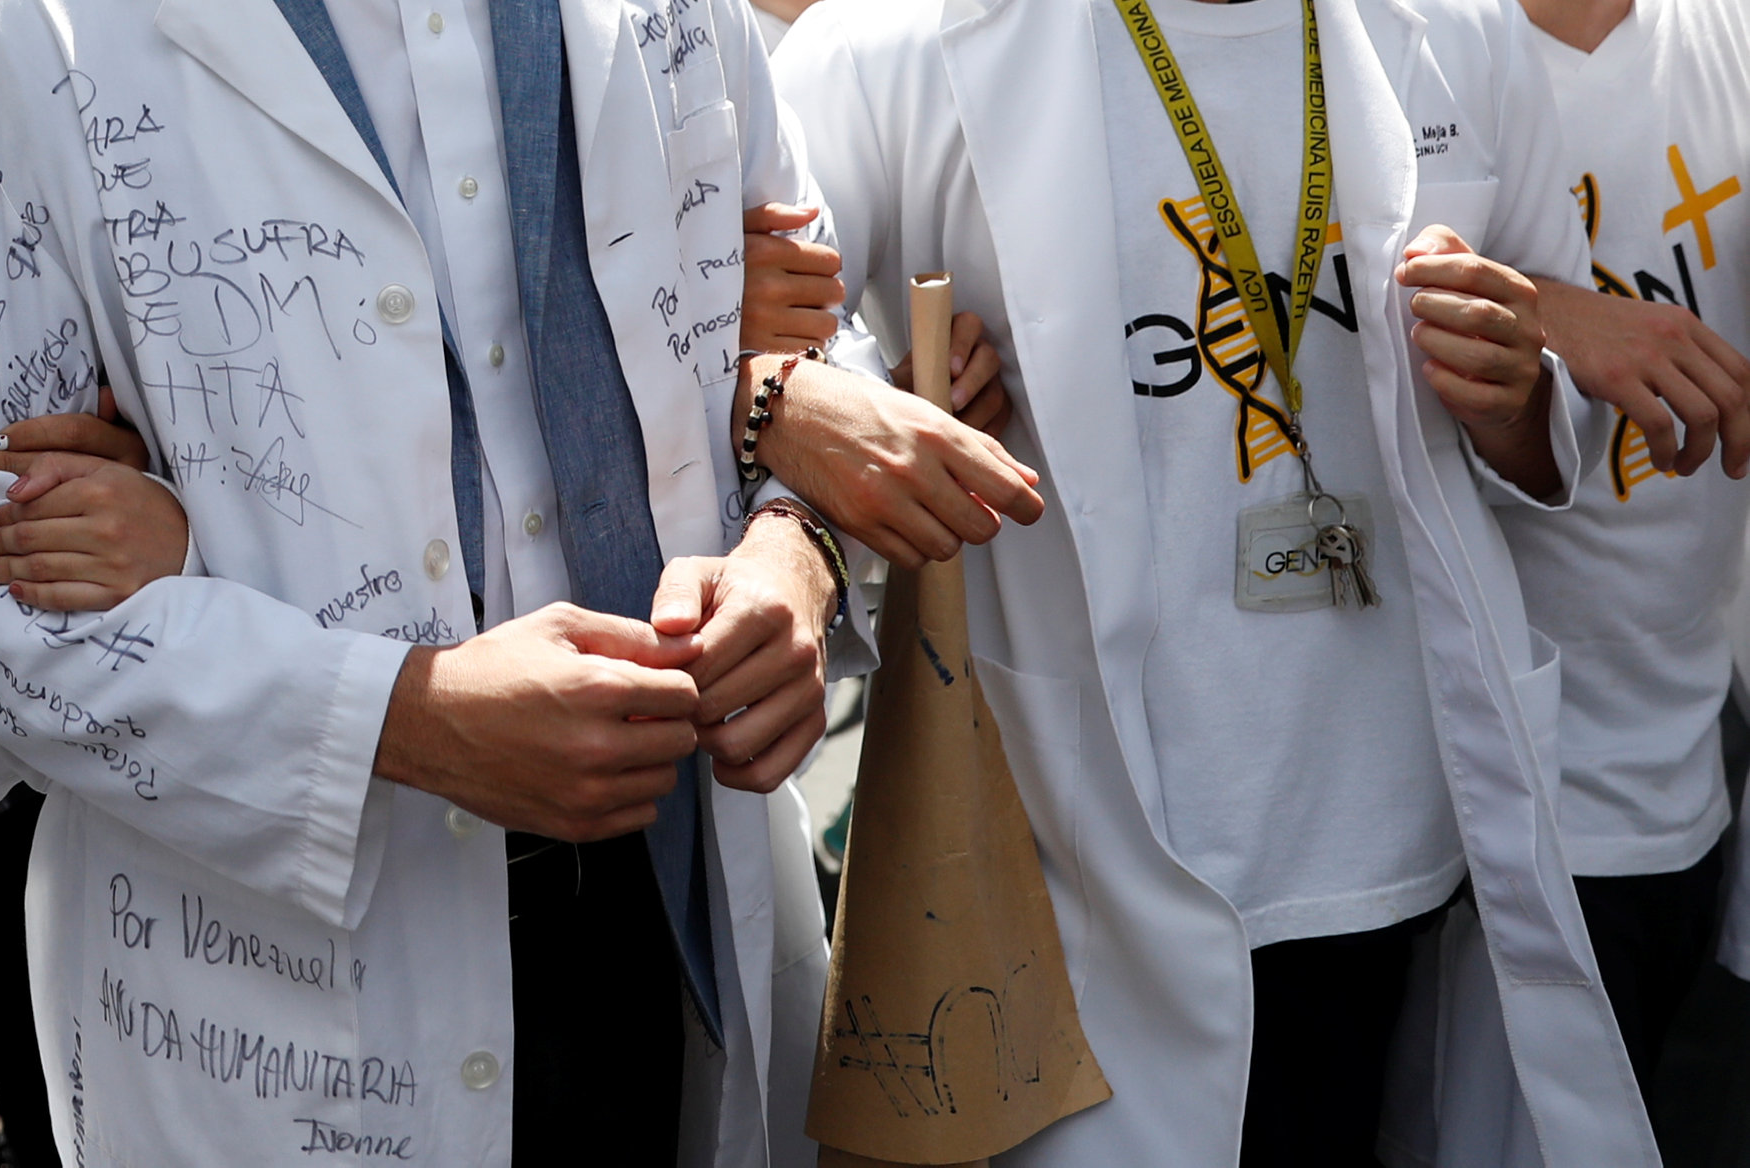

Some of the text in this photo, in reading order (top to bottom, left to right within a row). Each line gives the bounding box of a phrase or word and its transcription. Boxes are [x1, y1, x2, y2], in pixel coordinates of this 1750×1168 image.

[1127, 1, 1185, 103] MEDICINA
[1174, 105, 1200, 137] DE
[1308, 62, 1328, 166] MEDICINA
[1190, 137, 1242, 239] ESCUELA
[1305, 171, 1325, 221] LUIS
[1238, 268, 1268, 312] UCV
[1294, 227, 1320, 319] RAZETTI
[109, 873, 367, 993] Por Venezuela
